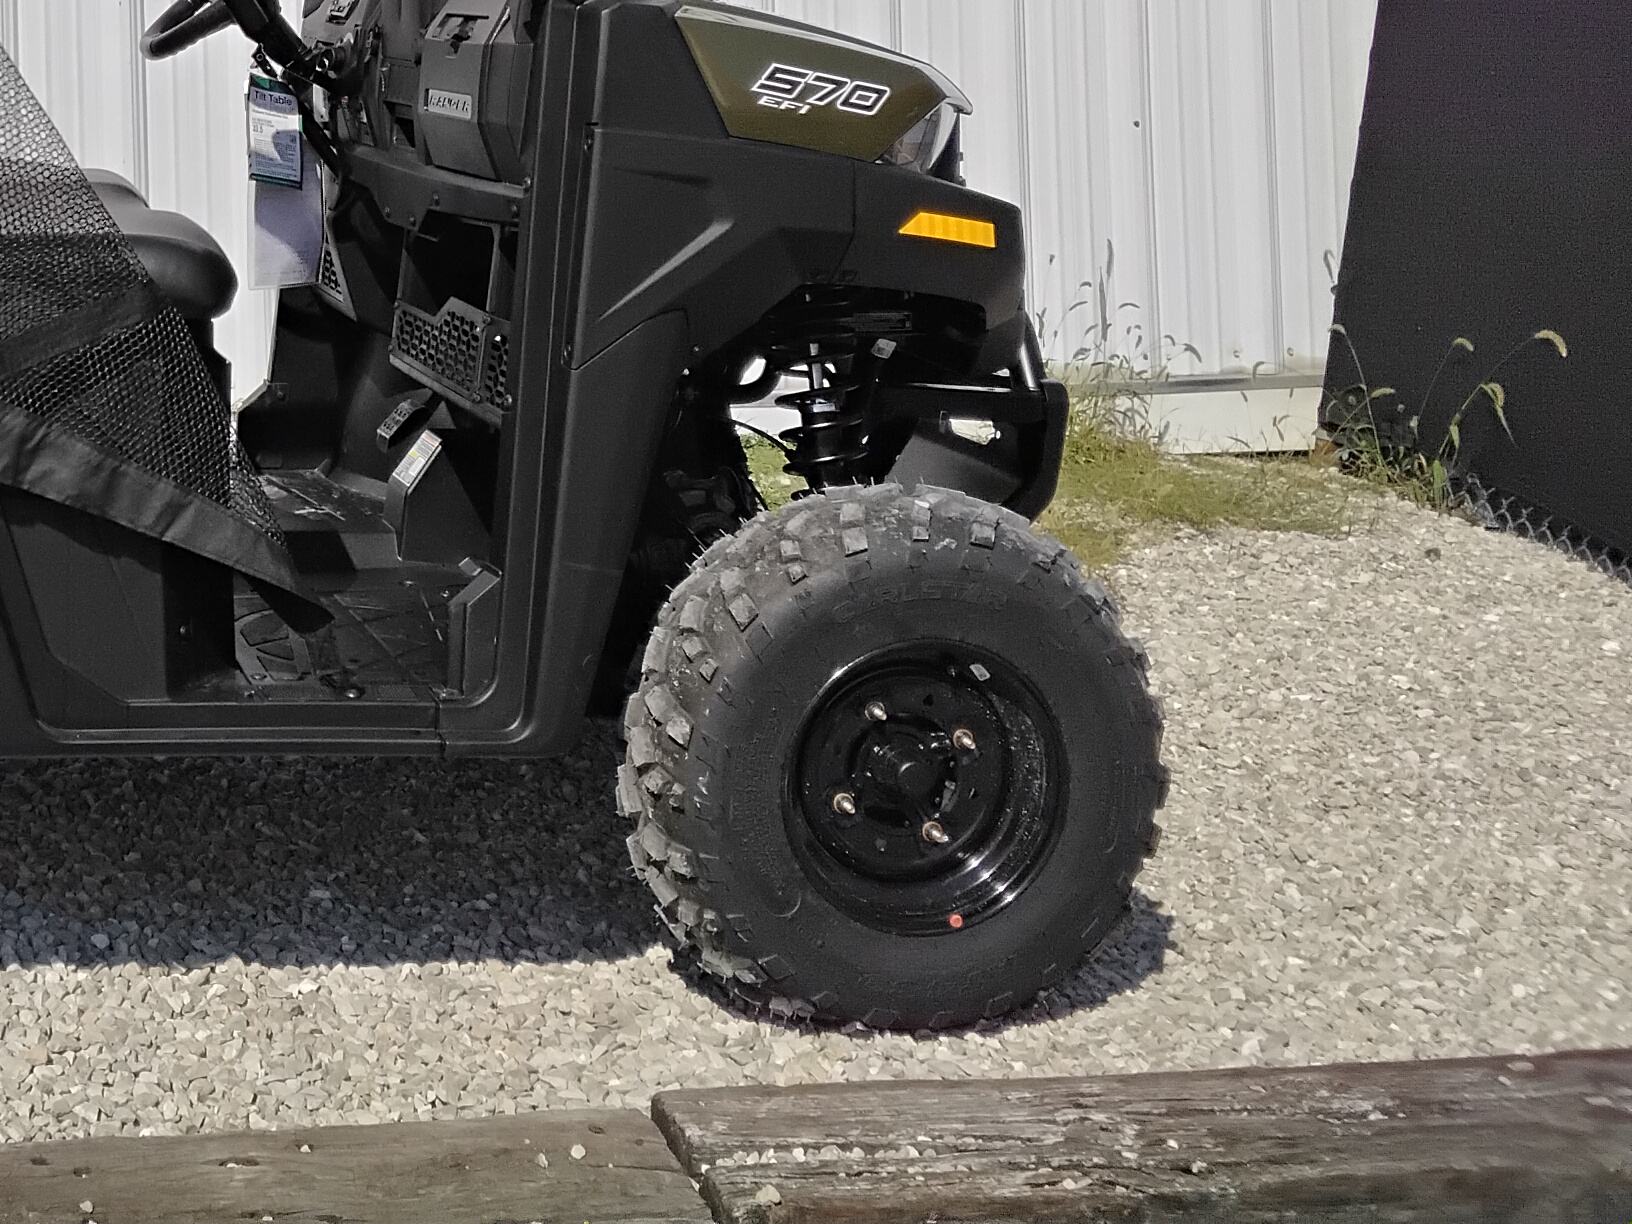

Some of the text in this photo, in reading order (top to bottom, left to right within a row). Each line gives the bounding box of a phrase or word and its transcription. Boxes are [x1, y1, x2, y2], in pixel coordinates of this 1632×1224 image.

[751, 63, 891, 116] 570
[268, 94, 293, 106] Table
[757, 96, 813, 115] EFI
